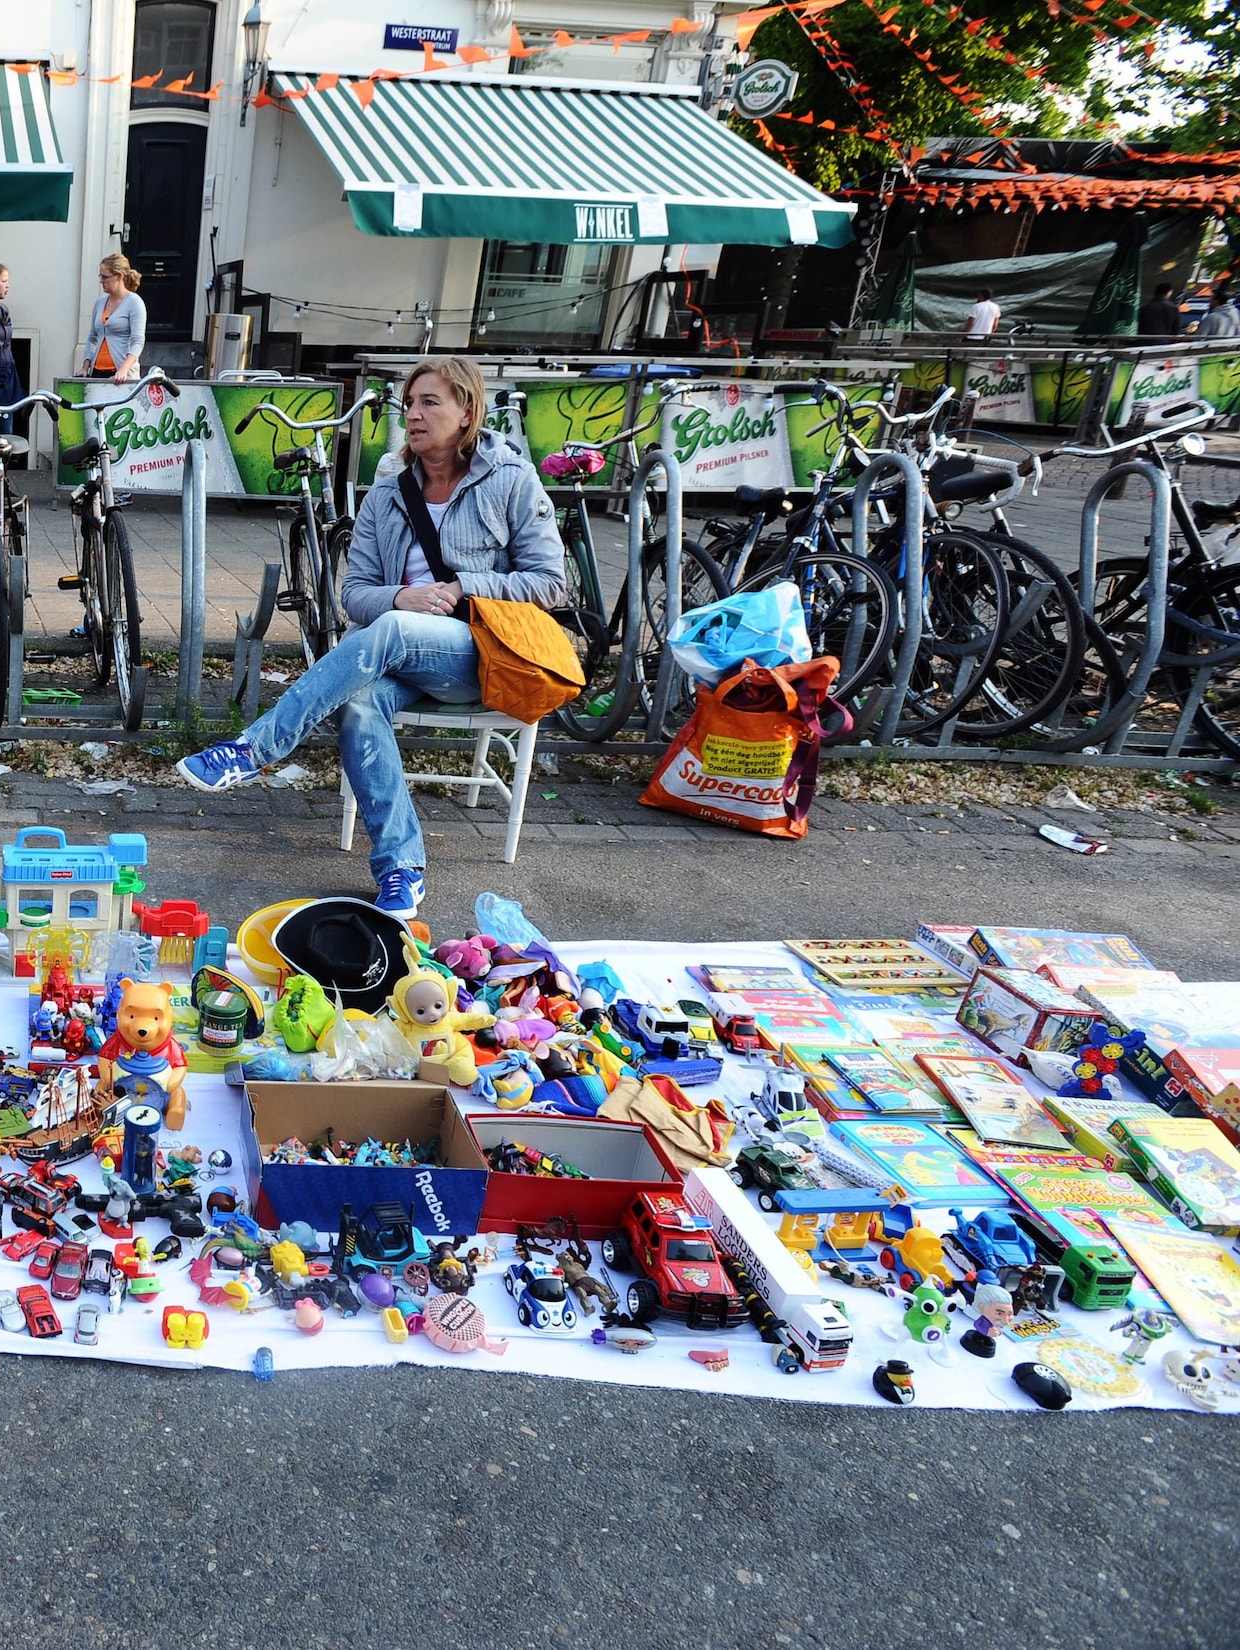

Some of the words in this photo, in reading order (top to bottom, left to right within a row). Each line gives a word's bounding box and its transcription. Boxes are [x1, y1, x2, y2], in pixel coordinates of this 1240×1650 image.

[391, 26, 453, 42] WESTERSTRAAT
[968, 373, 1025, 399] Grolsch
[94, 405, 213, 464] Grolsch
[671, 407, 776, 464] Grolsch
[129, 457, 175, 476] PREMIUM
[696, 457, 738, 474] PREMIUM
[739, 450, 769, 462] PILSNER
[705, 745, 719, 755] Nog
[707, 763, 742, 773] Product
[415, 1170, 451, 1233] Reebok
[721, 1215, 768, 1281] SANDERS
[717, 1226, 770, 1300] LOGISTICS
